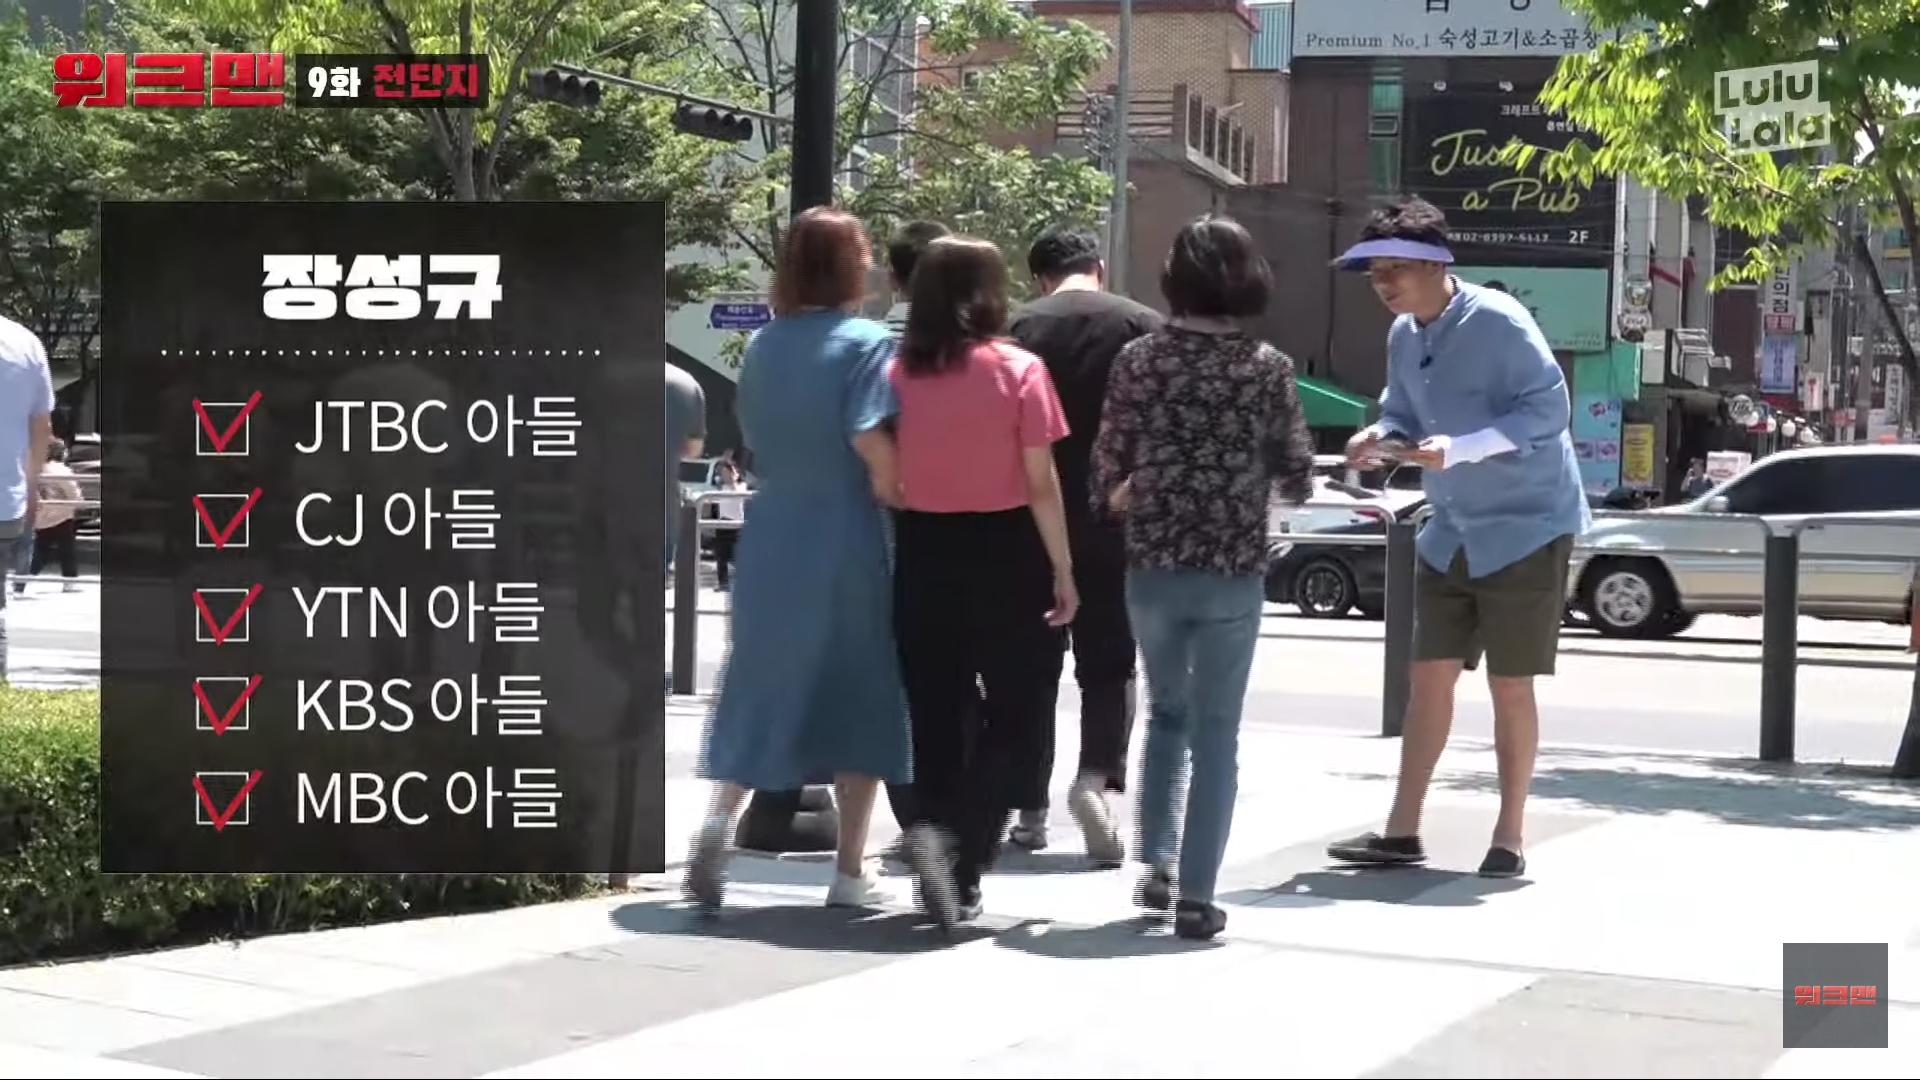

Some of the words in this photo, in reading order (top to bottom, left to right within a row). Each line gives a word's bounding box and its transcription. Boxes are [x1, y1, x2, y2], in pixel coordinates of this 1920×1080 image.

[1306, 32, 1383, 48] Premium
[1431, 129, 1520, 176] Jus
[1462, 190, 1488, 211] a
[1487, 177, 1580, 212] Pub
[1568, 229, 1590, 244] 2F
